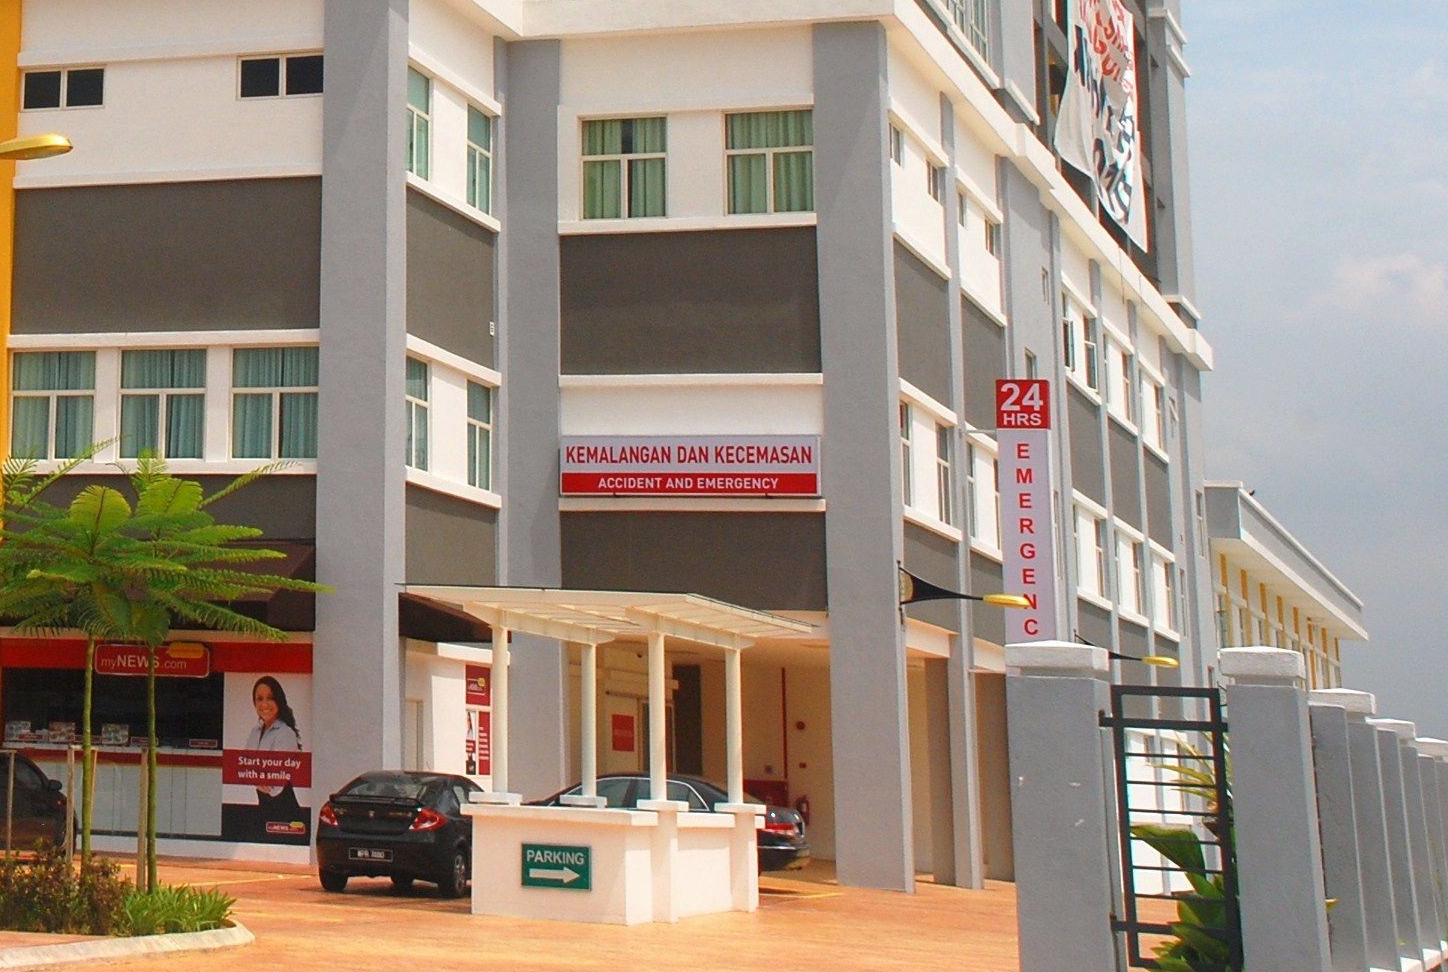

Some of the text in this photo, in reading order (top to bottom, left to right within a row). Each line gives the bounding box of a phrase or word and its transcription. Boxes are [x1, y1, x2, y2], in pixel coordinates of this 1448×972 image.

[1000, 383, 1043, 412] 24
[1003, 413, 1042, 426] HRS
[566, 446, 812, 464] KEMALANGAN DAN KECEMASAN
[598, 477, 779, 489] ACCIDENT AND EMERGENCY
[1016, 443, 1039, 636] EMERGENC
[238, 756, 301, 769] Start your day
[237, 770, 258, 779] with
[266, 771, 291, 780] smile
[526, 850, 585, 865] PARKING
